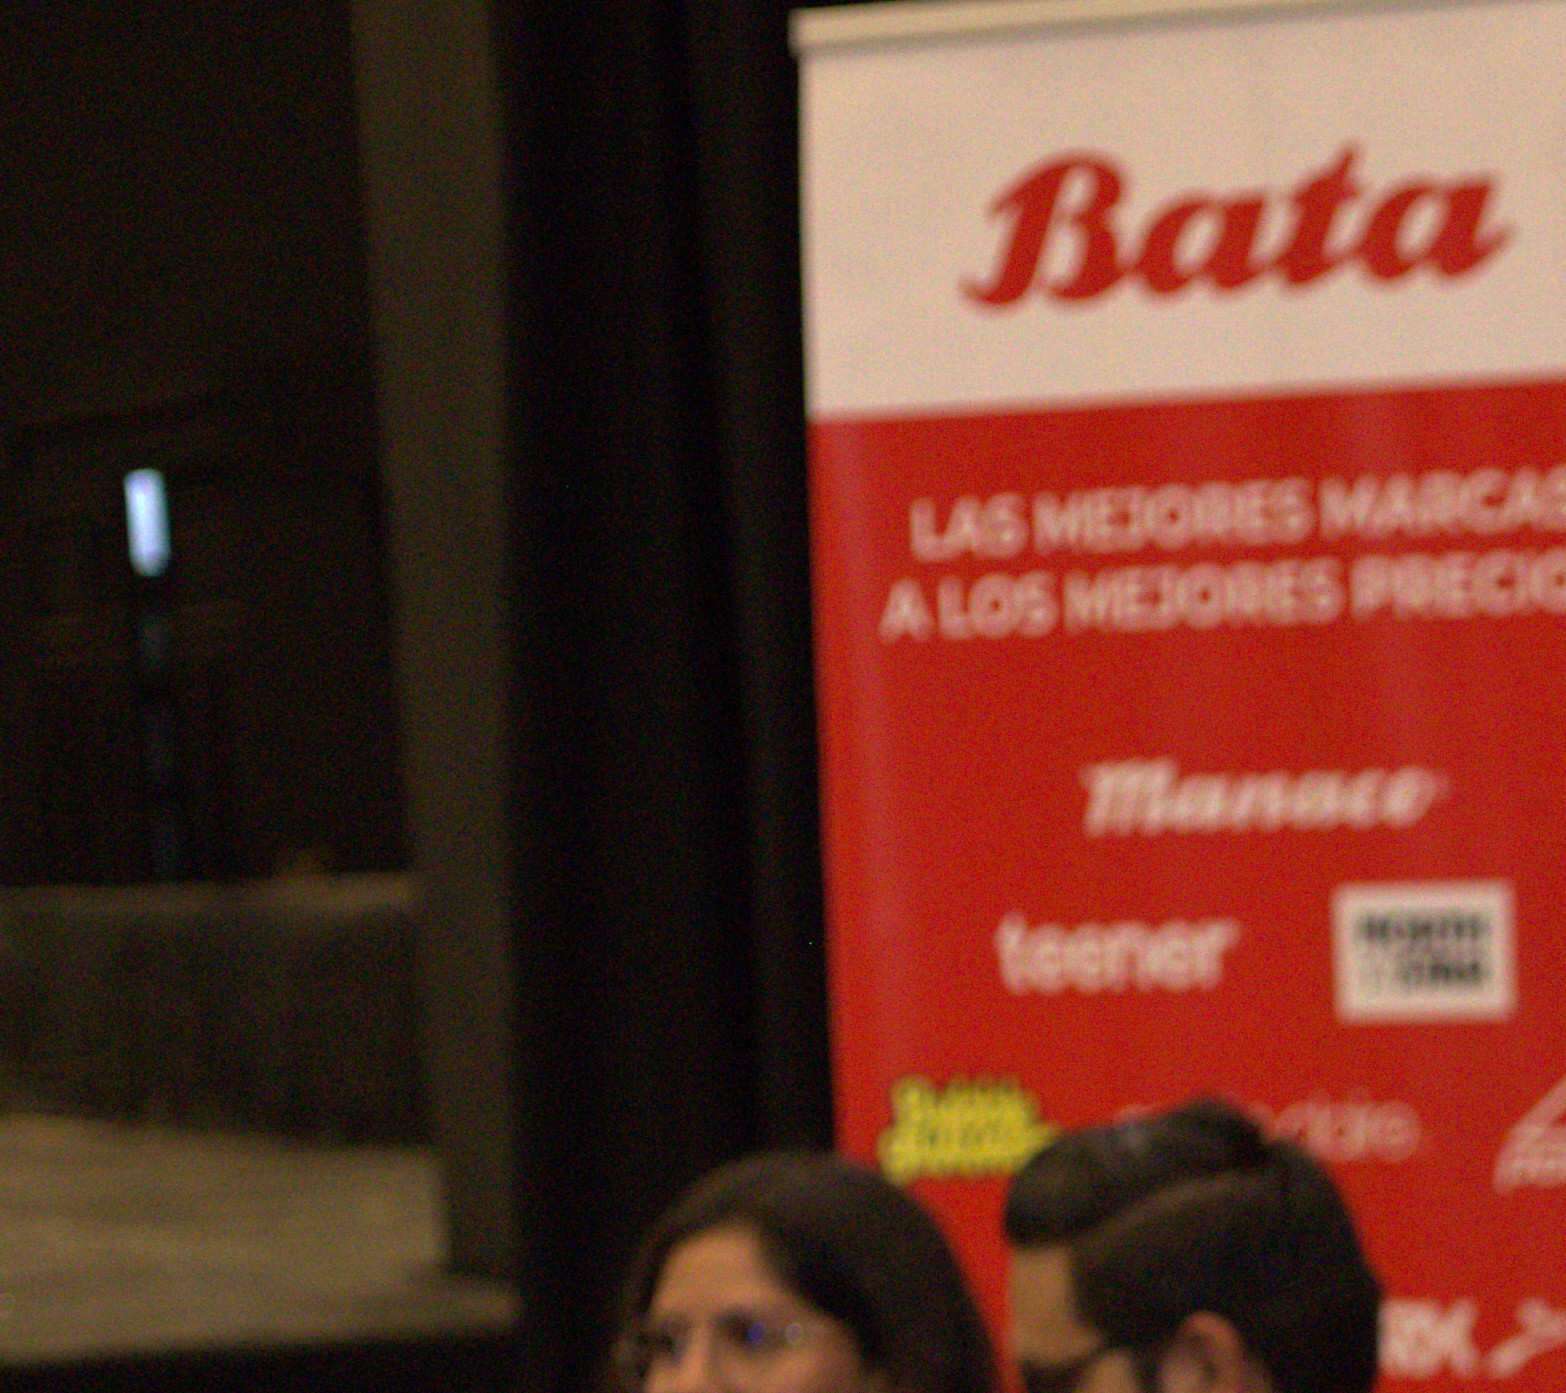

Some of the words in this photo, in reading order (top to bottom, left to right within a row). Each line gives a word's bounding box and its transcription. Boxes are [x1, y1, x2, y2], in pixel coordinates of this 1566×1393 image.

[957, 139, 1517, 314] Bata
[910, 494, 1029, 561] LAS
[1034, 477, 1314, 554] MEJORES
[879, 580, 934, 645] A
[939, 572, 1057, 641] LOS
[1065, 557, 1342, 634] MEJORES
